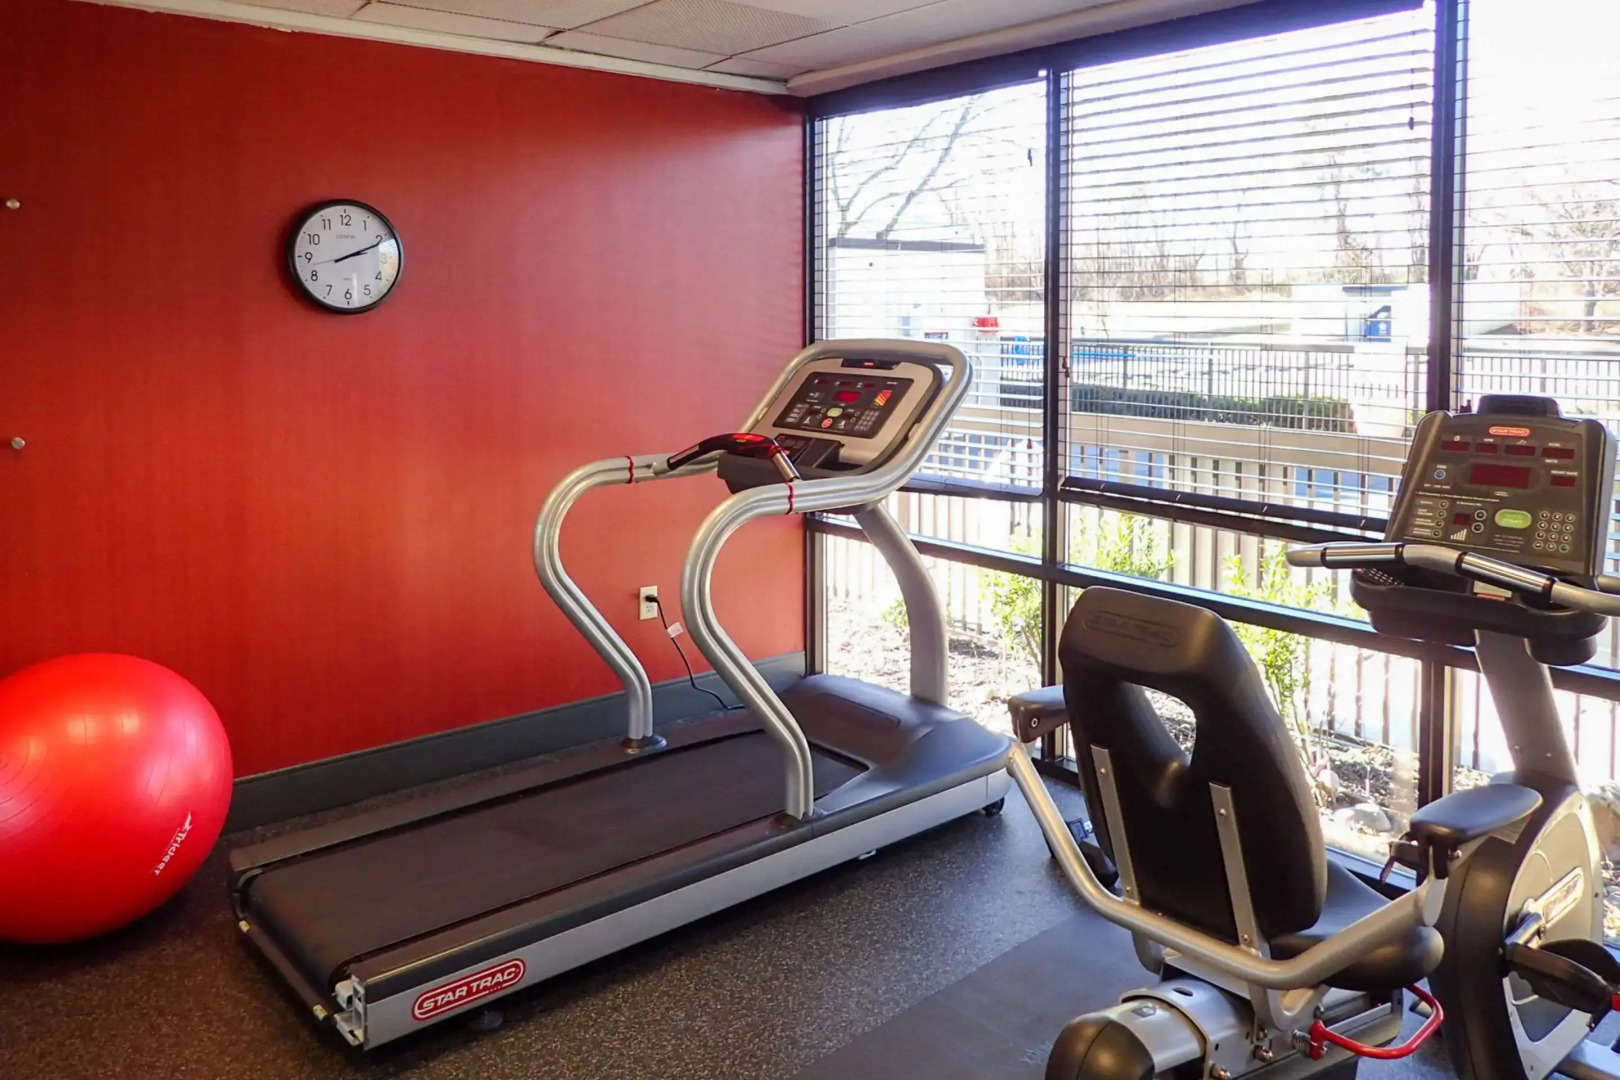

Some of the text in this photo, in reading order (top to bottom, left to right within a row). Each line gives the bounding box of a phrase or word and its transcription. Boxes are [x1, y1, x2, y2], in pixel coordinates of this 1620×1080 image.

[322, 218, 332, 231] 11
[340, 214, 352, 226] 12
[362, 219, 367, 231] 1
[307, 233, 321, 246] 10
[304, 251, 313, 263] 9
[380, 253, 387, 264] 3
[310, 270, 318, 281] 8
[375, 271, 382, 281] 4
[325, 285, 333, 296] 7
[344, 288, 352, 300] 6
[363, 285, 371, 296] 5
[422, 967, 516, 1010] STAR TRAC
